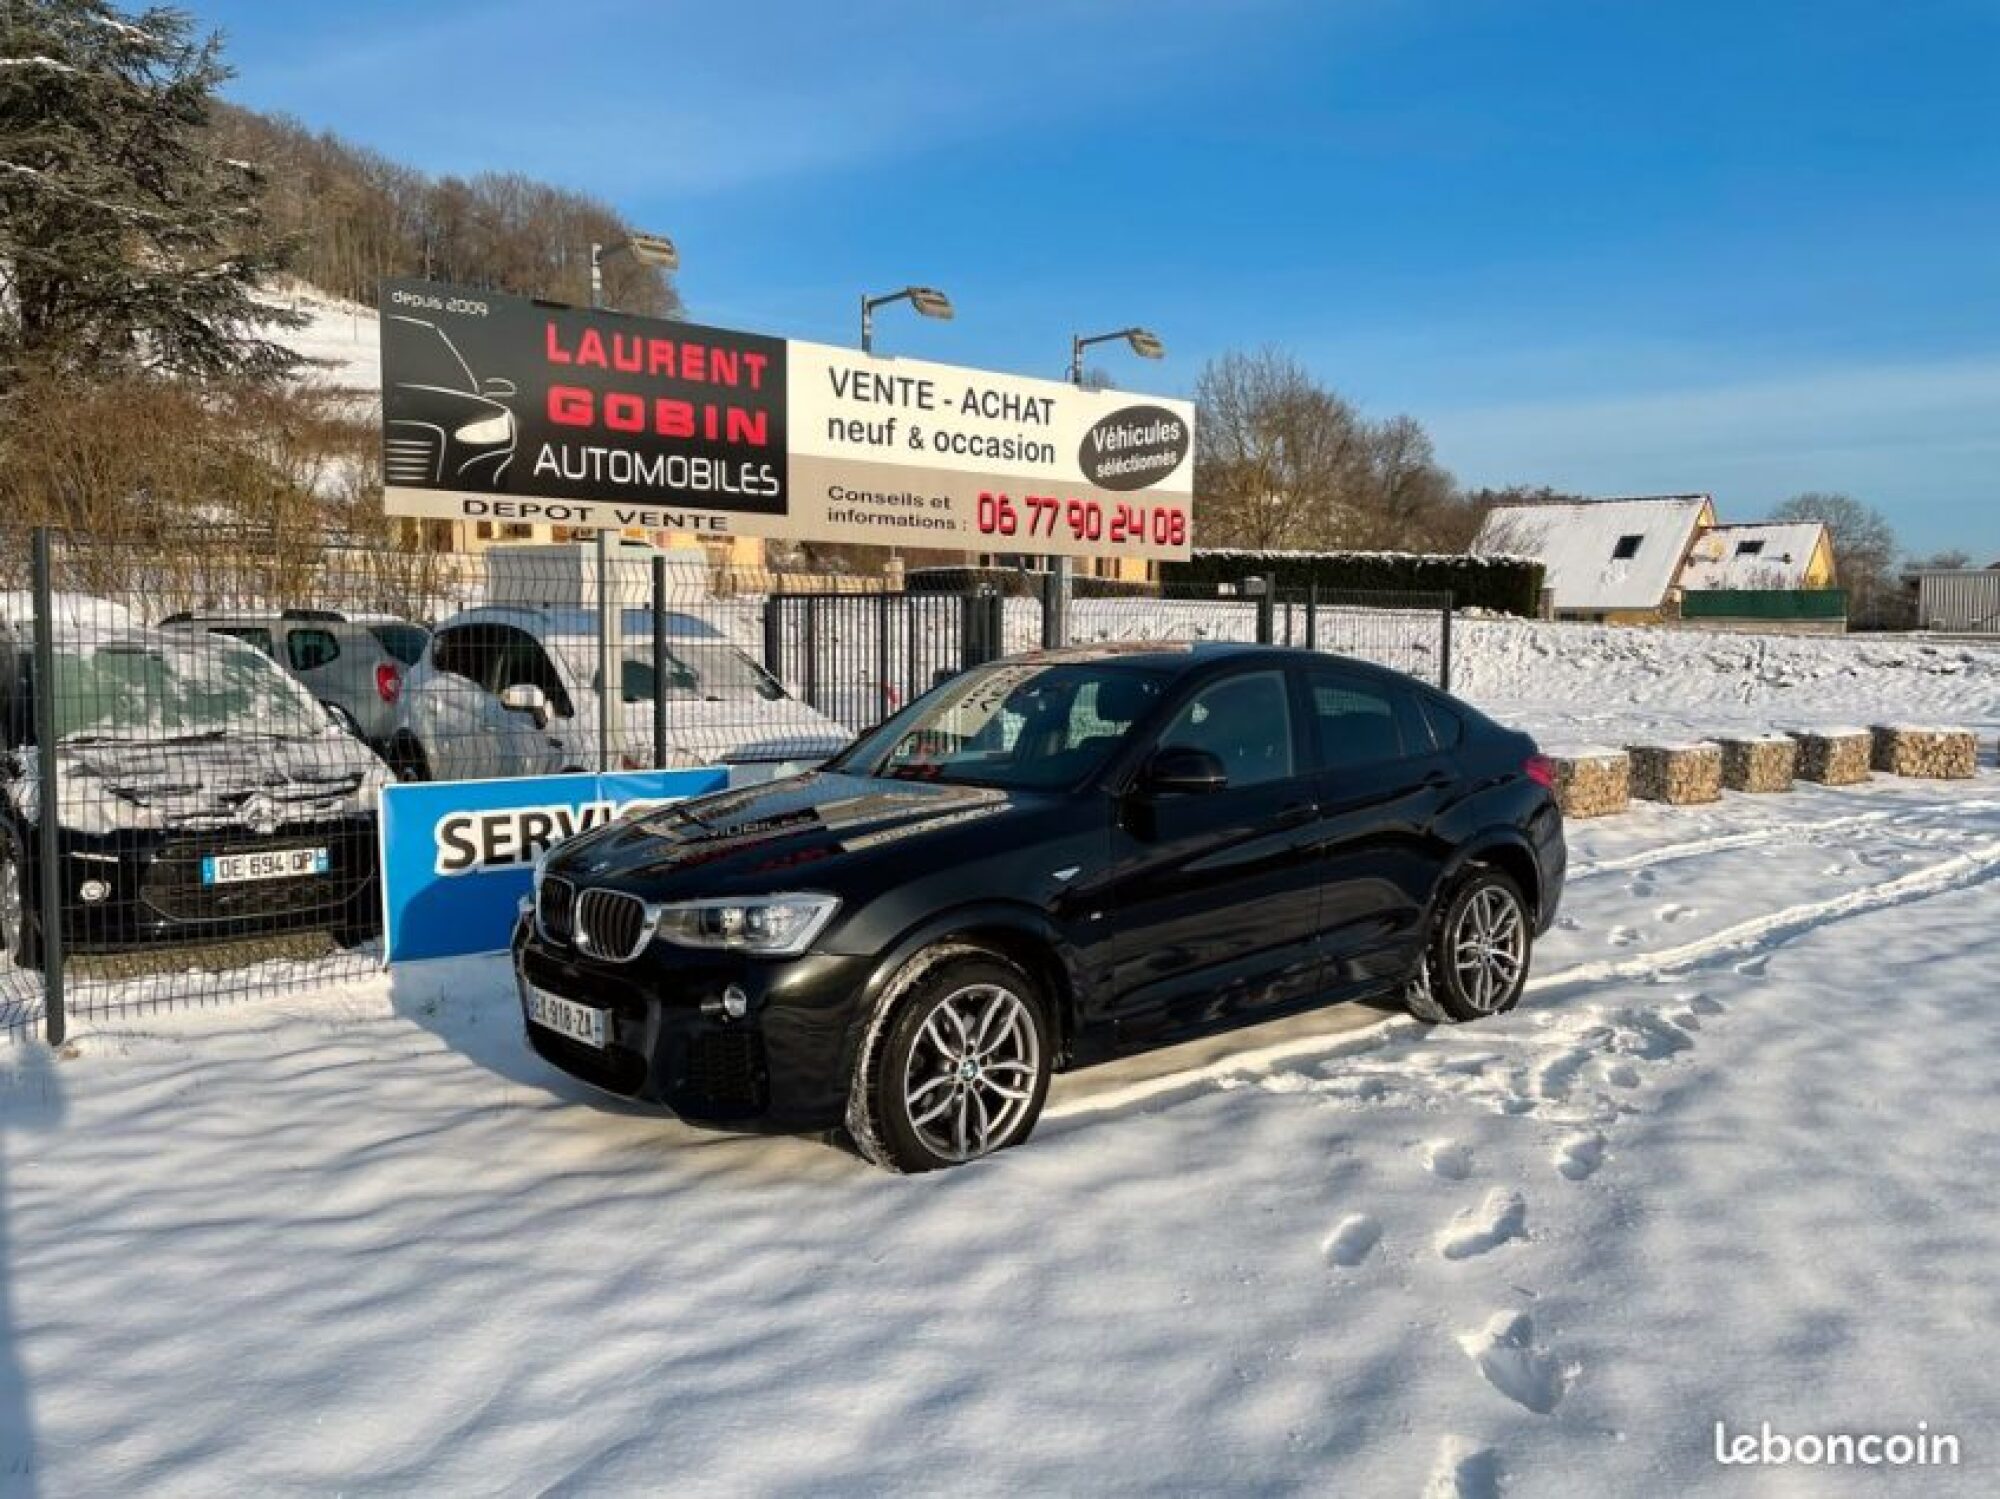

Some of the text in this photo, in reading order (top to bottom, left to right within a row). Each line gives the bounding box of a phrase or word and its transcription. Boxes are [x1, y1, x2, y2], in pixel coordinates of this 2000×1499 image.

[391, 290, 489, 316] depuis 2009
[546, 321, 768, 390] LAURENT
[547, 385, 768, 446] GOBIN
[828, 366, 935, 411] VENTE
[961, 387, 1056, 426] ACHAT
[828, 416, 1056, 464] neuf & occasion
[1092, 418, 1181, 453] Véhicules
[533, 442, 780, 496] AUTOMOBILES
[463, 499, 728, 531] DEPOT VENTE
[828, 485, 951, 510] Conseils et
[828, 507, 956, 530] informations
[978, 491, 1185, 545] 06 77 90 24 08
